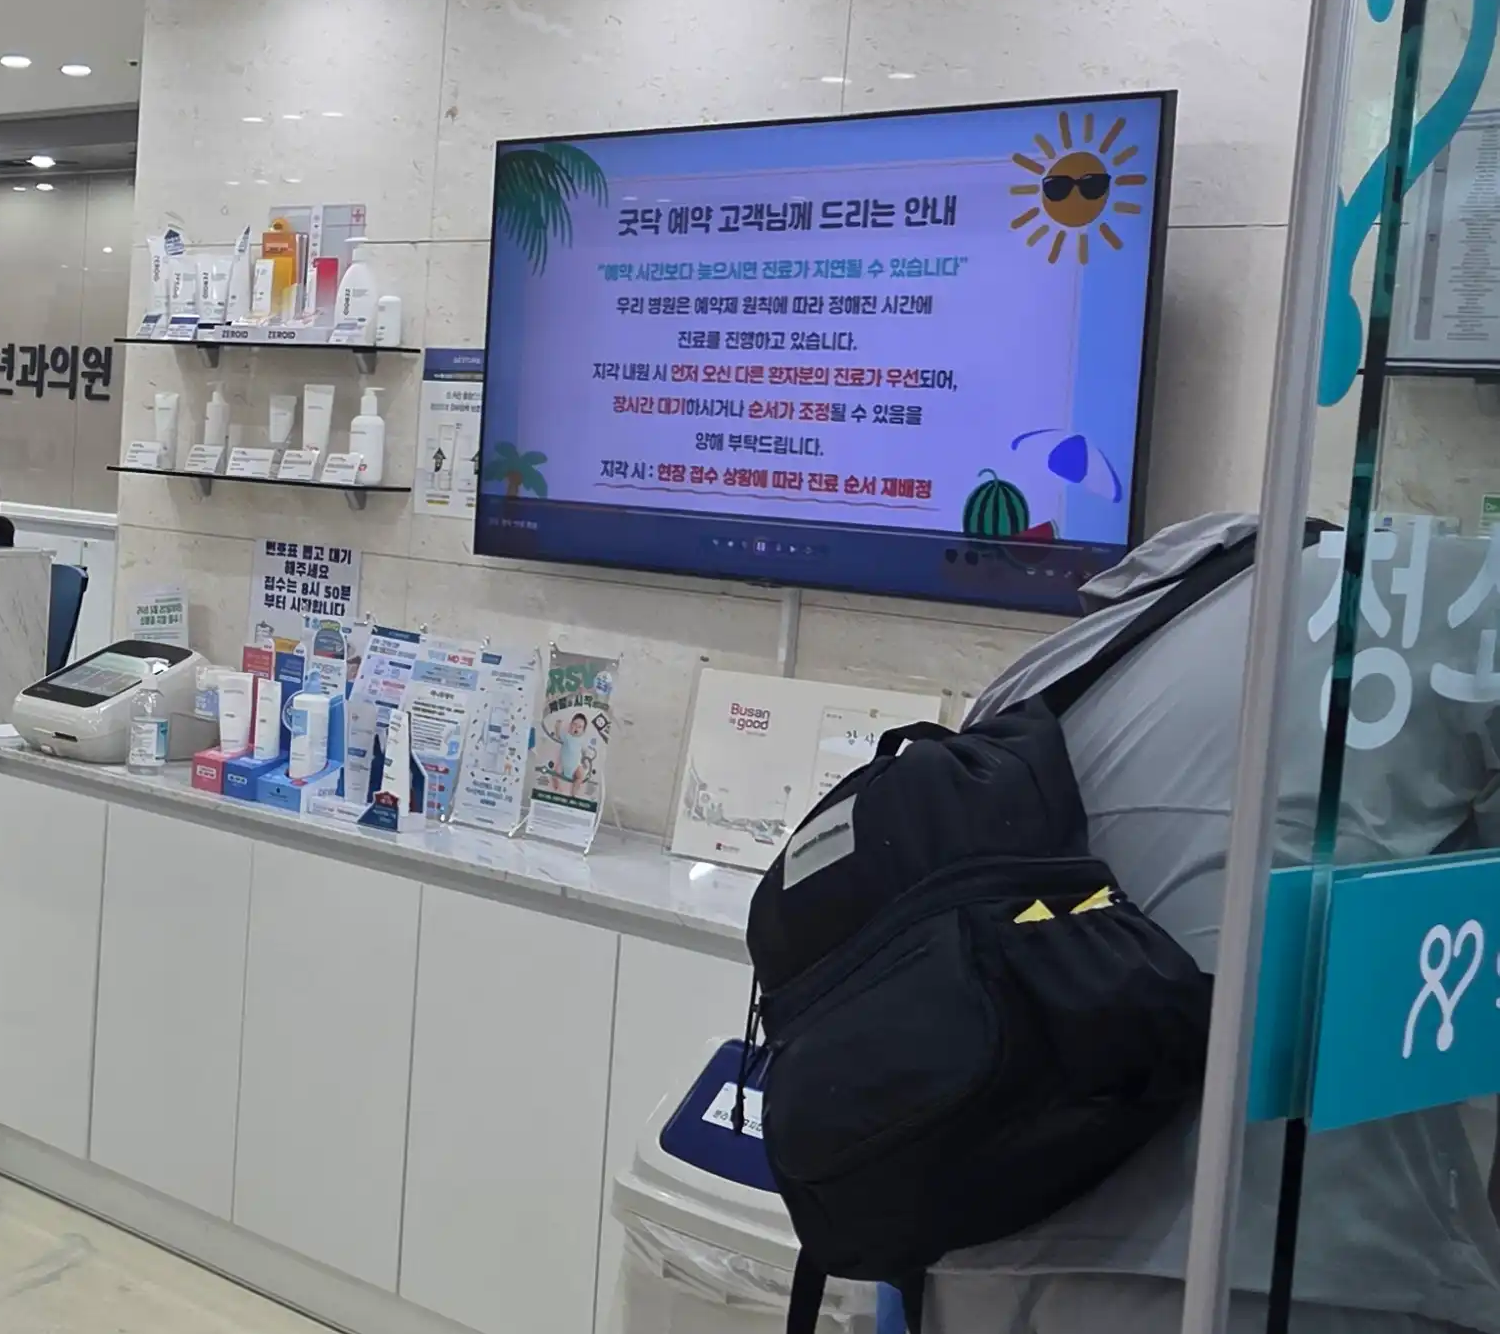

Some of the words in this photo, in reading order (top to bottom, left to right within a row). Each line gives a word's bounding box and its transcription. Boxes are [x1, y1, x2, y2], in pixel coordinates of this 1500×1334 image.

[618, 208, 662, 236] 굿닥
[668, 206, 714, 235] 예약
[717, 202, 813, 233] 고객님께
[819, 199, 896, 229] 드리는
[904, 194, 957, 227] 안내
[635, 261, 694, 281] 시간보다
[697, 260, 758, 280] 늦으시면
[762, 258, 811, 280] 진료가
[813, 258, 863, 279] 지연될
[867, 258, 885, 278] 수
[616, 297, 644, 315] 우리
[648, 296, 690, 315] 병원은
[695, 296, 738, 315] 예약제
[742, 295, 788, 315] 원칙에
[792, 295, 824, 315] 따라
[828, 295, 877, 315] 정해진
[881, 295, 933, 315] 시간에
[221, 329, 249, 339] ZEROID
[267, 330, 296, 340] ZEROID
[678, 331, 720, 349] 진료를
[725, 331, 785, 350] 진행하고
[790, 332, 857, 351] 있습니다.
[593, 362, 620, 380] 지각
[622, 363, 649, 381] 내원
[652, 363, 667, 381] 시
[671, 364, 698, 383] 먼저
[701, 365, 731, 383] 오신
[735, 365, 764, 384] 다른
[768, 366, 829, 386] 환자분의
[833, 368, 883, 387] 진료가
[886, 369, 958, 392] 우선되어,
[613, 395, 654, 414] 장시간
[657, 397, 744, 418] 대기하시거나
[748, 400, 795, 420] 순서가
[798, 402, 846, 422] 조정될
[851, 404, 867, 423] 수
[872, 404, 922, 425] 있음을
[695, 432, 724, 451] 양해
[728, 433, 824, 456] 부탁드립니다.
[600, 459, 629, 479] 지각
[657, 463, 685, 483] 현장
[690, 464, 718, 484] 접수
[723, 467, 768, 488] 상황에
[772, 470, 803, 491] 따라
[807, 472, 838, 493] 진료
[844, 475, 876, 496] 순서
[881, 477, 932, 499] 재배정
[266, 540, 298, 558] 번호표
[328, 548, 352, 565] 대기
[285, 560, 329, 579] 해주세요
[264, 576, 297, 594] 접수는
[301, 581, 320, 597] 8시
[324, 585, 351, 601] 50분
[264, 593, 286, 610] 부터
[290, 596, 345, 617] 시작합니다
[731, 702, 771, 718] Busan
[736, 718, 769, 731] good
